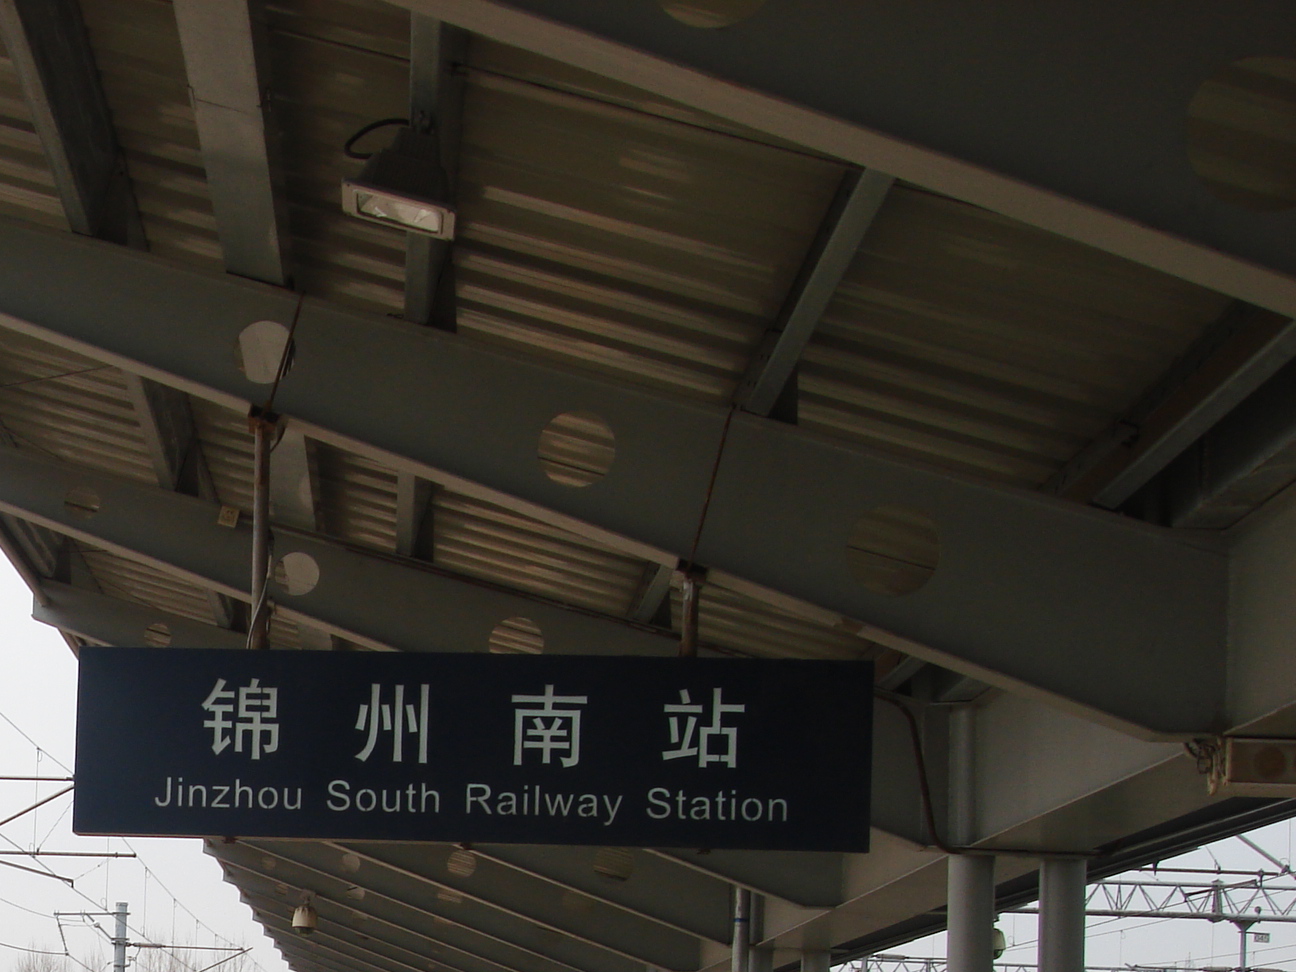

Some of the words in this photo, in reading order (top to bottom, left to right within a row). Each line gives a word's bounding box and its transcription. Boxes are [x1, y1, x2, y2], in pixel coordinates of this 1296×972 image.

[201, 678, 745, 768] 锦州南站
[154, 777, 302, 811] Jinzhou
[326, 780, 441, 813] South
[467, 784, 624, 826] Railway
[646, 788, 788, 822] Station
